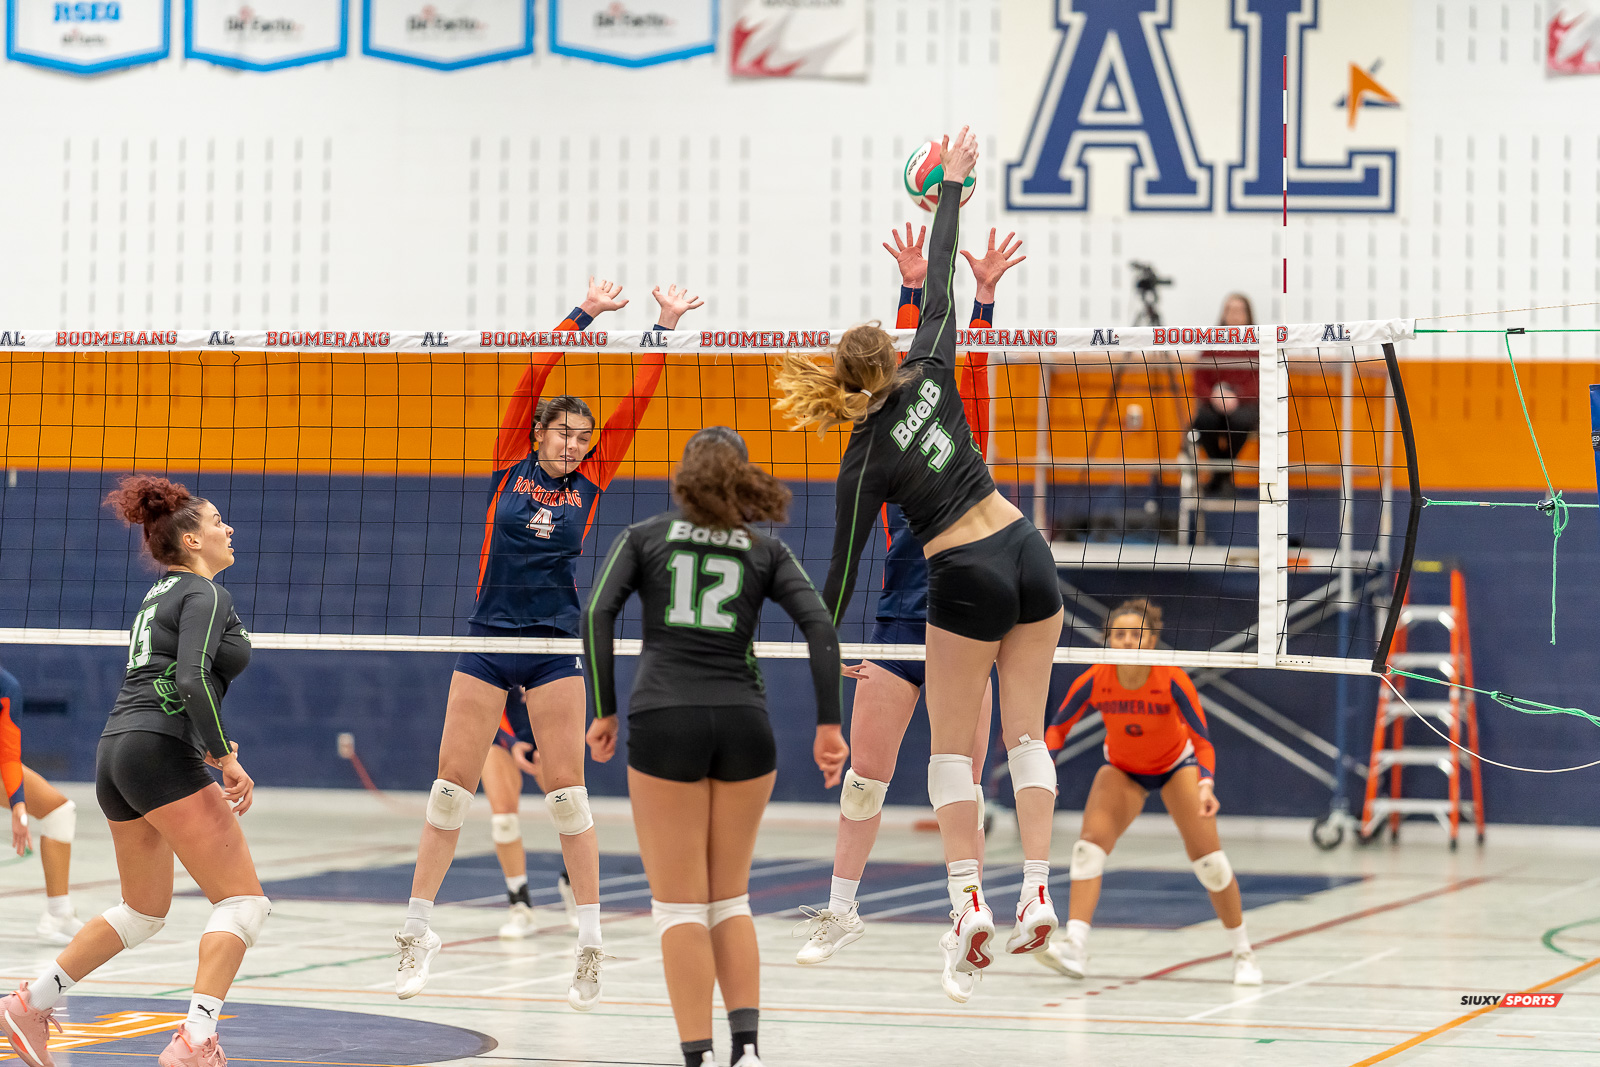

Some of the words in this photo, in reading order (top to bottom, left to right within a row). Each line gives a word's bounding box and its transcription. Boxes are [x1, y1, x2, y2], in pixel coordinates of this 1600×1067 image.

[1004, 0, 1398, 213] AL
[0, 330, 25, 346] AL
[55, 330, 178, 346] BOOMERANG
[208, 330, 235, 346] AL
[265, 331, 391, 347] BOOMERANG
[421, 331, 449, 347] AL
[480, 331, 608, 347] BOOMERANG
[640, 331, 667, 347] AL
[700, 331, 831, 348] BOOMERANG
[955, 329, 1057, 346] OMERANG
[1090, 328, 1119, 346] AL
[1153, 326, 1288, 345] BOOMERAG
[1321, 324, 1350, 342] AL
[890, 378, 942, 451] BdeB
[526, 507, 556, 540] 4
[665, 549, 744, 632] 12
